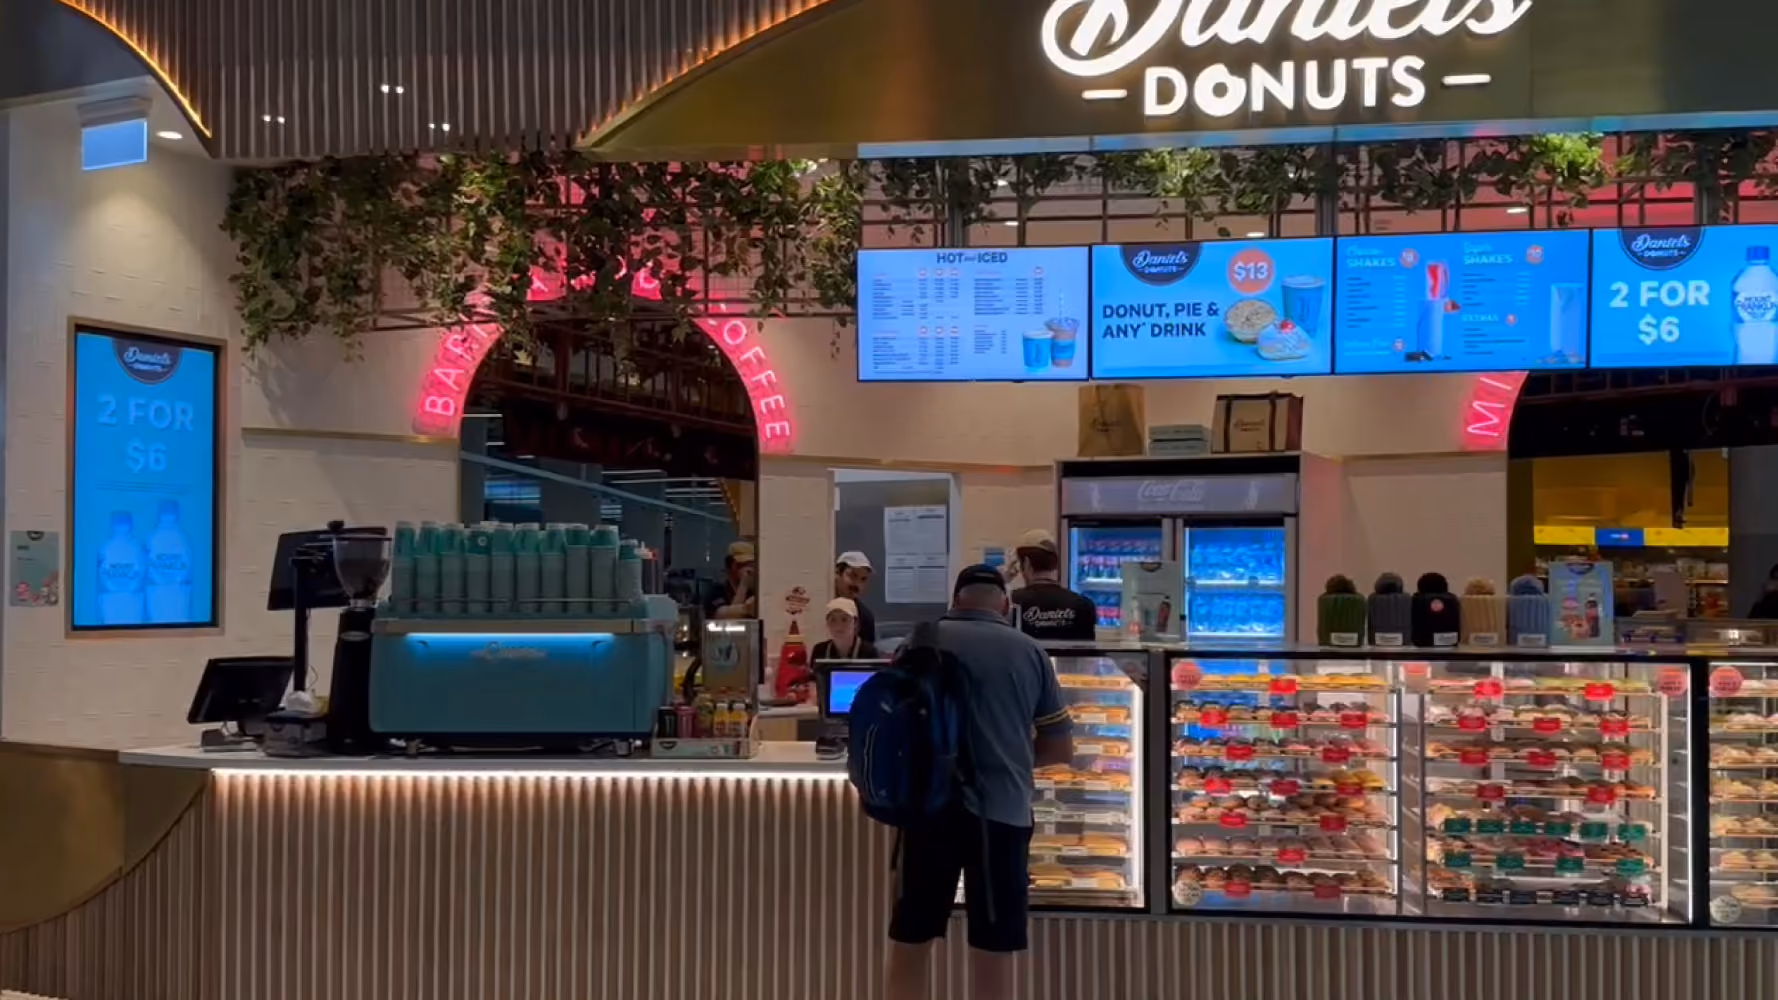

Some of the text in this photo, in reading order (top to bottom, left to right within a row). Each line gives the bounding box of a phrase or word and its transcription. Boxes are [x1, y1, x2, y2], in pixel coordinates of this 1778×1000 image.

[1144, 56, 1427, 117] DONUTS
[936, 252, 964, 264] HOT
[977, 252, 1008, 263] ICED
[1234, 262, 1269, 282] $13
[1609, 280, 1710, 308] 2 FOR
[1103, 302, 1219, 319] DONUT, PIE &
[1150, 323, 1206, 338] DRINK
[1638, 313, 1680, 345] $6
[98, 395, 194, 431] 2 FOR
[127, 437, 167, 473] $6
